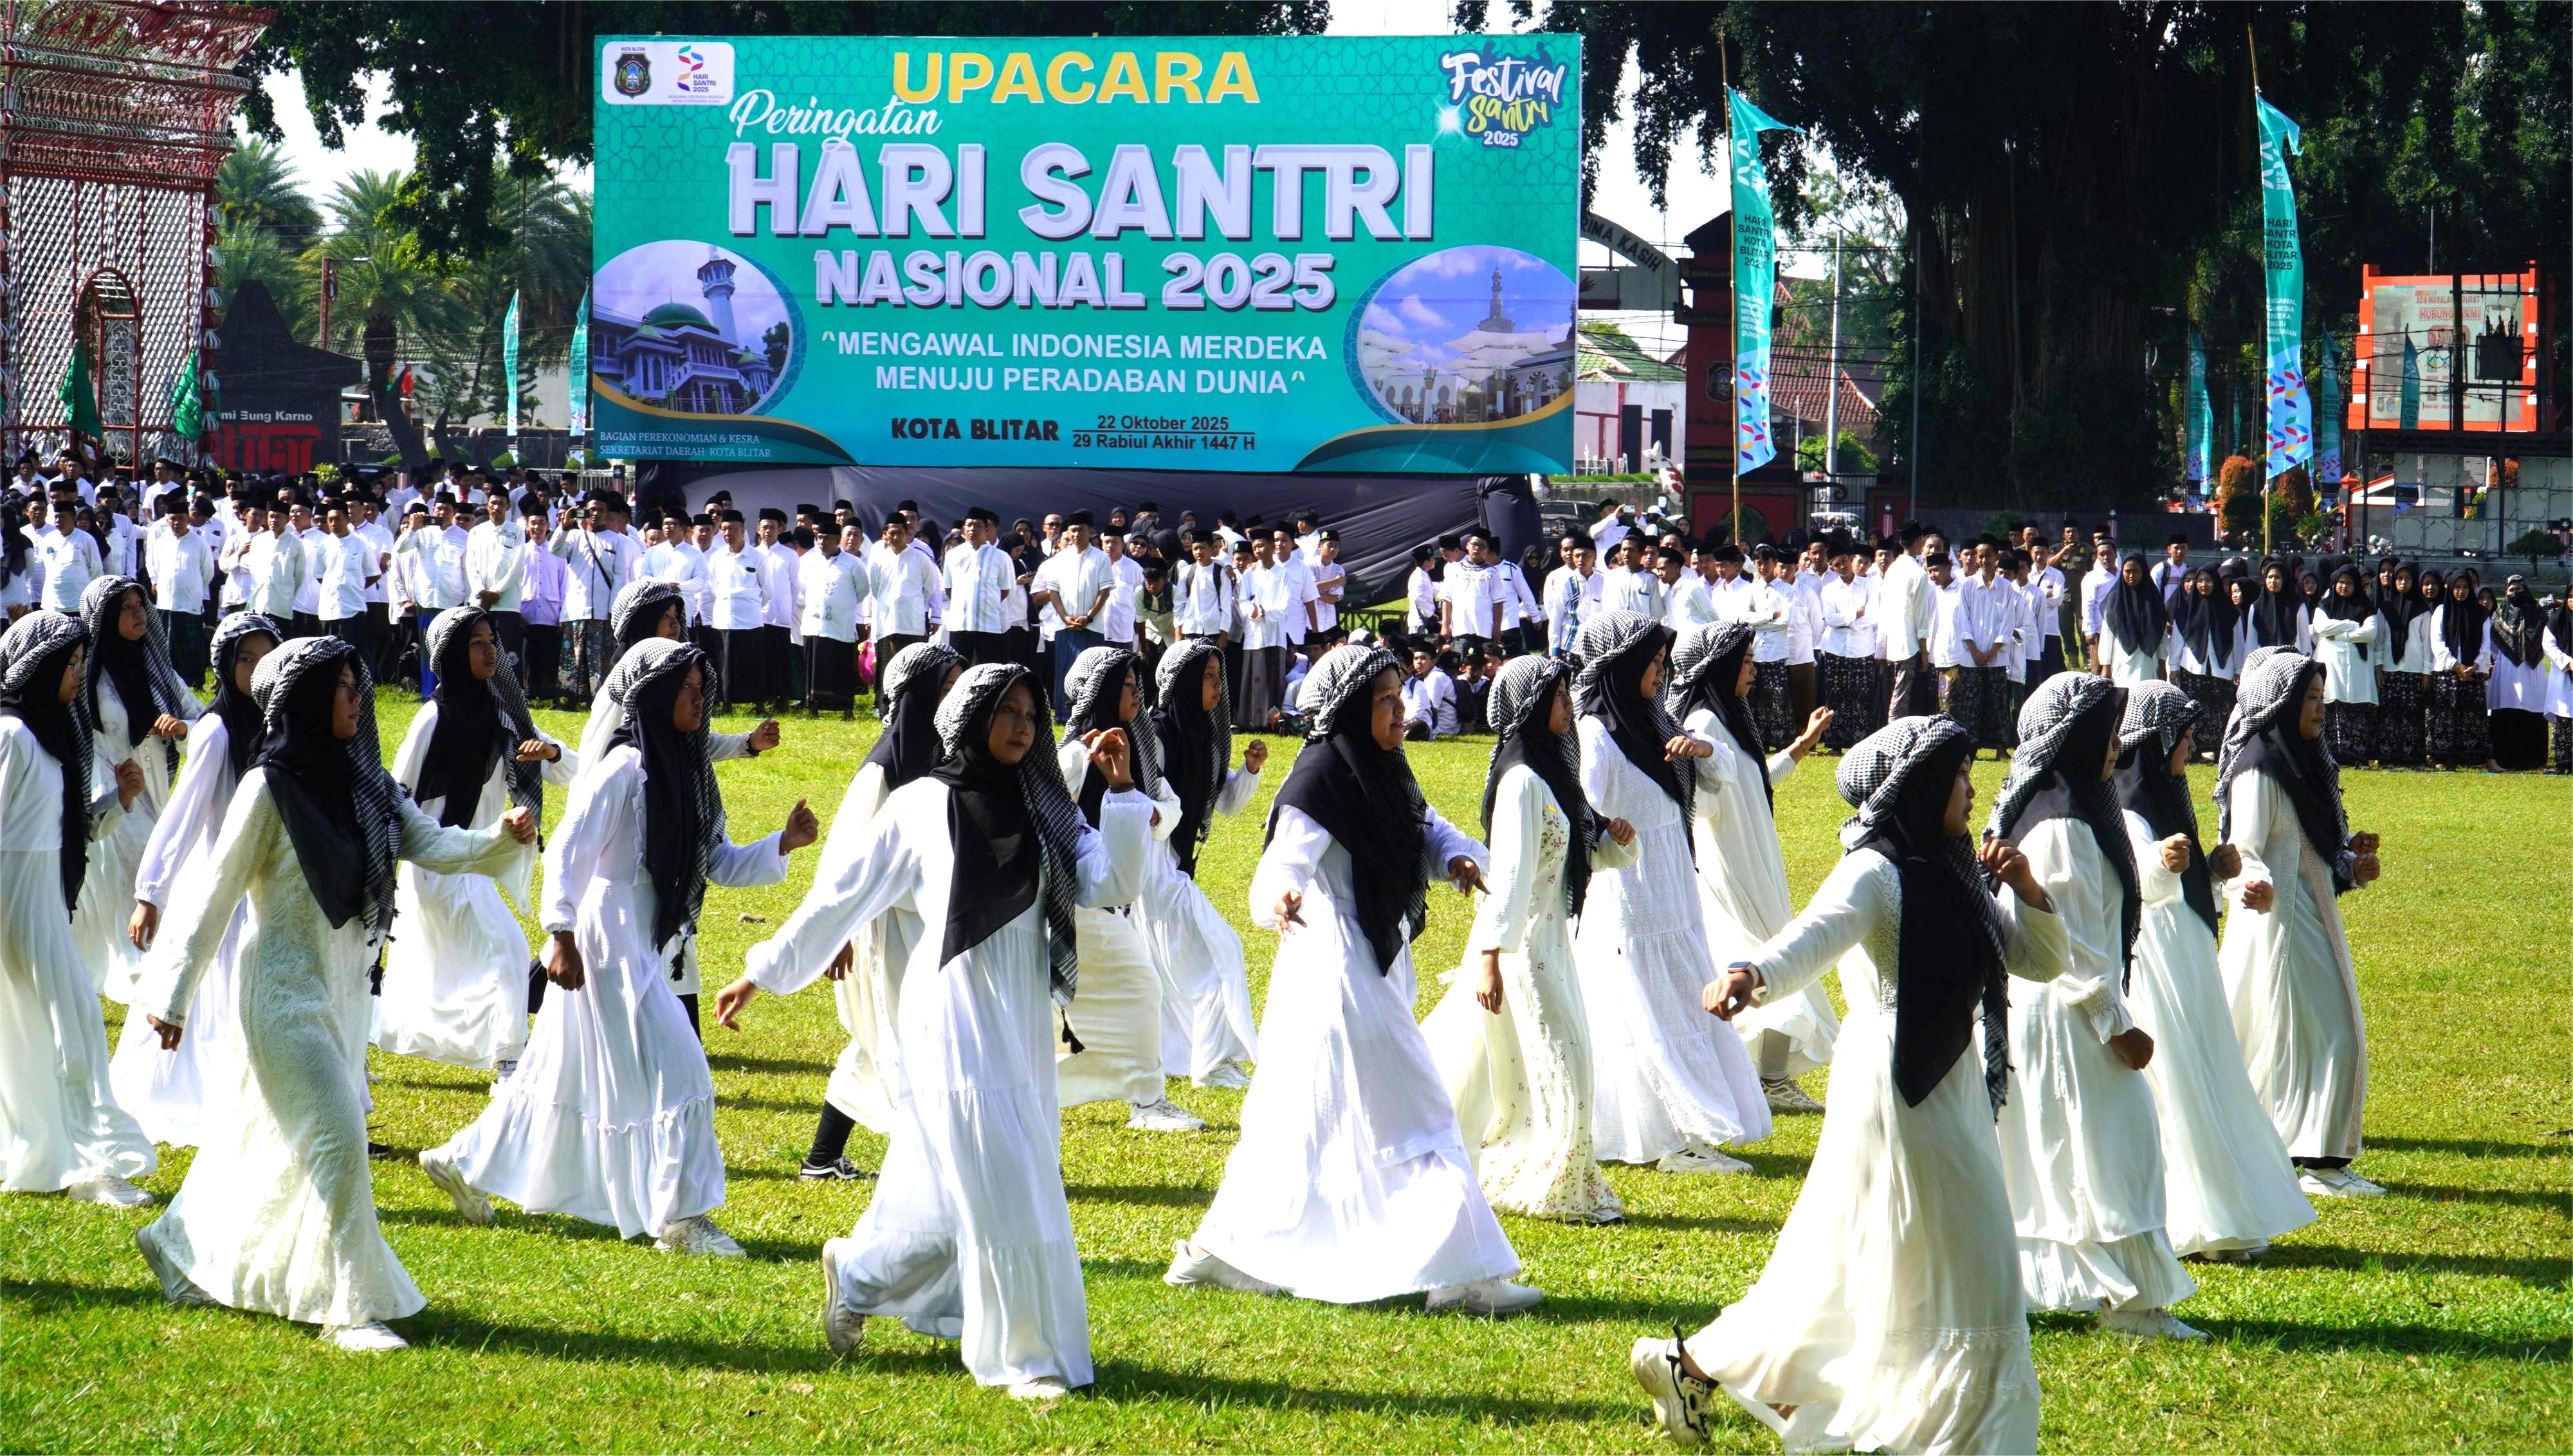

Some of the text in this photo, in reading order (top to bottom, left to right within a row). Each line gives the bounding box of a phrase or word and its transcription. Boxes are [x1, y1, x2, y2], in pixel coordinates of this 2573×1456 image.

[893, 51, 1260, 104] UPACARA
[1442, 53, 1565, 104] Festival
[729, 89, 943, 152] Peringatan
[1483, 131, 1519, 146] 2025
[725, 142, 1434, 242] HARI SANTRI
[1744, 214, 1766, 227] HARI
[2267, 218, 2292, 227] HARI
[1744, 235, 1766, 248] KOTA
[2265, 229, 2297, 239] ANTR
[1582, 216, 1663, 272] RIMA KASIH
[2266, 240, 2293, 250] KOTA
[1739, 245, 1770, 260] BLITAR
[1744, 257, 1765, 269] 2025
[2267, 260, 2293, 270] 2025
[814, 250, 1337, 311] NASIONAL 2025
[2420, 308, 2480, 320] HUBUNG AMI
[1012, 334, 1172, 359] INDONESIA
[1180, 335, 1328, 360] MERDEKA
[875, 365, 993, 390] MENUJU
[1003, 367, 1186, 393] PERADABAN
[221, 410, 313, 423] mi Bung Karno
[1097, 415, 1229, 431] 22 Oktober 2025
[891, 417, 1060, 441] KOTA BLITAR
[600, 432, 760, 444] BAGIAN PEREKONOMIAN & KESRA
[1072, 433, 1256, 450] 29 Rabiul Akhir 1447 H
[600, 444, 772, 457] SEKRETARIAT DAERAH KOTA BLITAR
